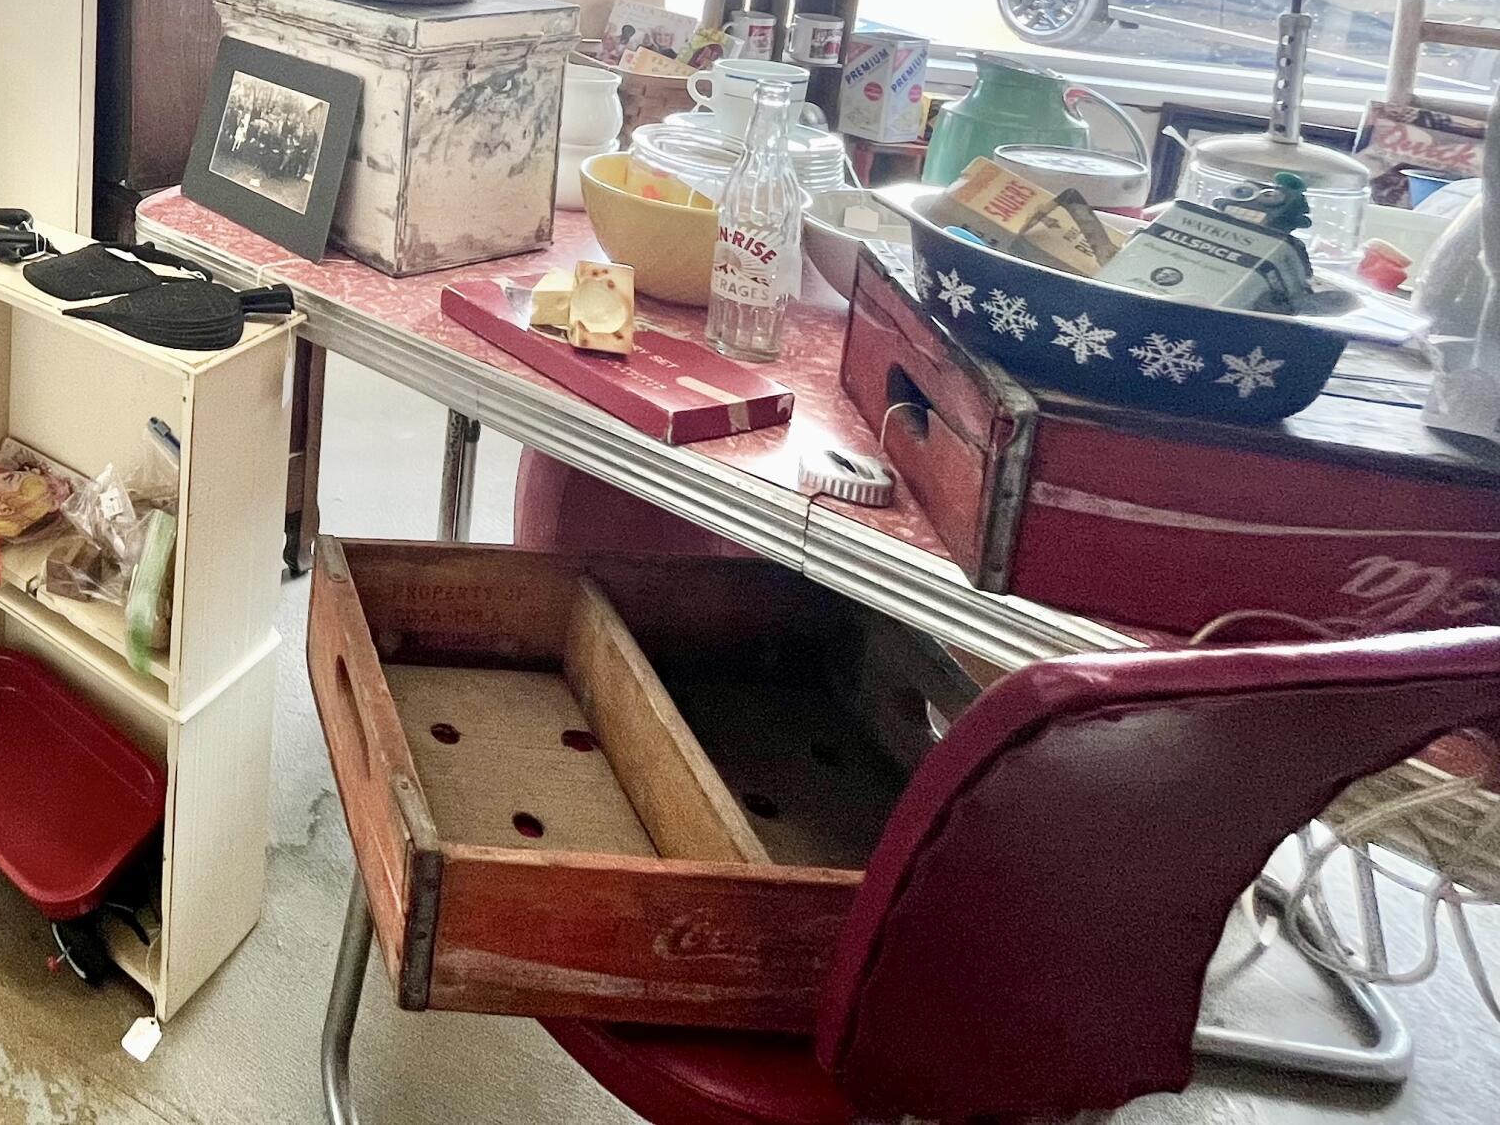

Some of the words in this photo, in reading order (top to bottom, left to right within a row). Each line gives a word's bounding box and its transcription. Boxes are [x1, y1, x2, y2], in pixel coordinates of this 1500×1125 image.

[844, 48, 889, 85] PREMIUM
[890, 48, 928, 93] PREMIUM
[1160, 229, 1242, 262] ALLSPICE
[1181, 216, 1257, 246] WATKINS
